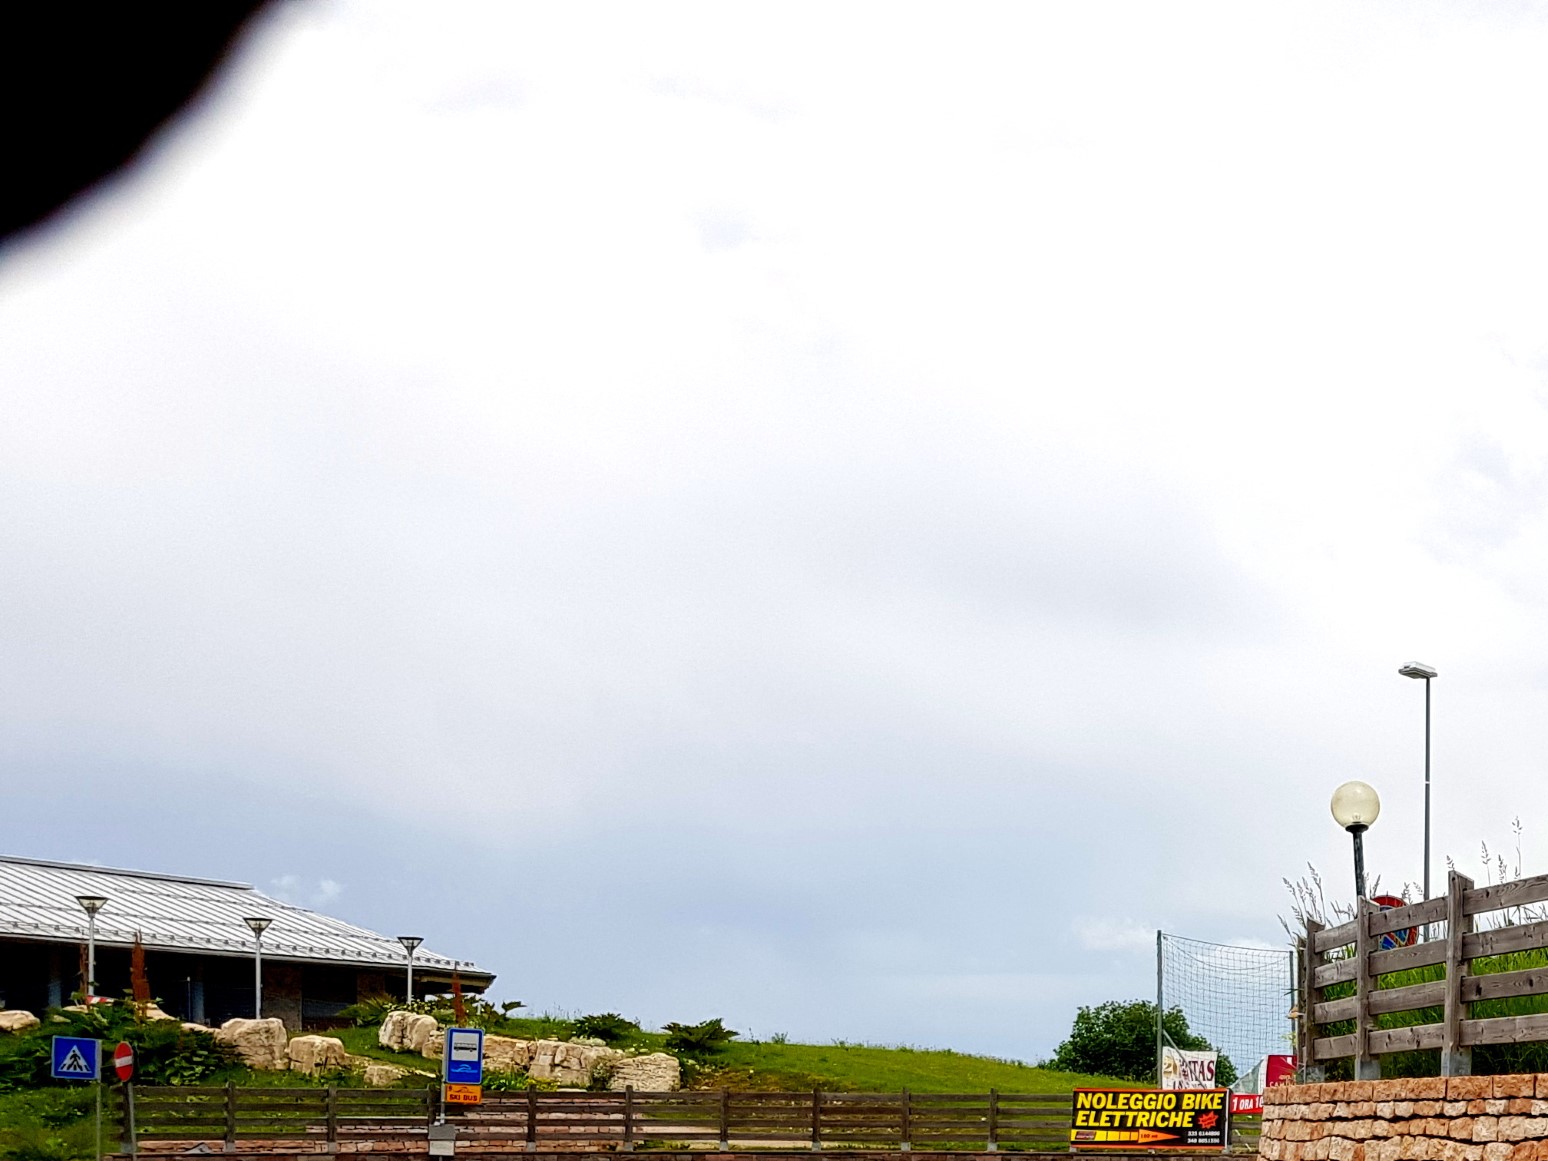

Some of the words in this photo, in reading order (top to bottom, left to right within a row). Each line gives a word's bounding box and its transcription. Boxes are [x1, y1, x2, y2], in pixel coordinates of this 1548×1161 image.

[463, 1094, 478, 1102] BUS
[1076, 1092, 1177, 1110] NOLEGGIO
[1181, 1092, 1225, 1110] BIKE
[1232, 1096, 1239, 1111] 1
[1239, 1098, 1253, 1110] ORA
[1075, 1111, 1195, 1128] ELETTRICHE
